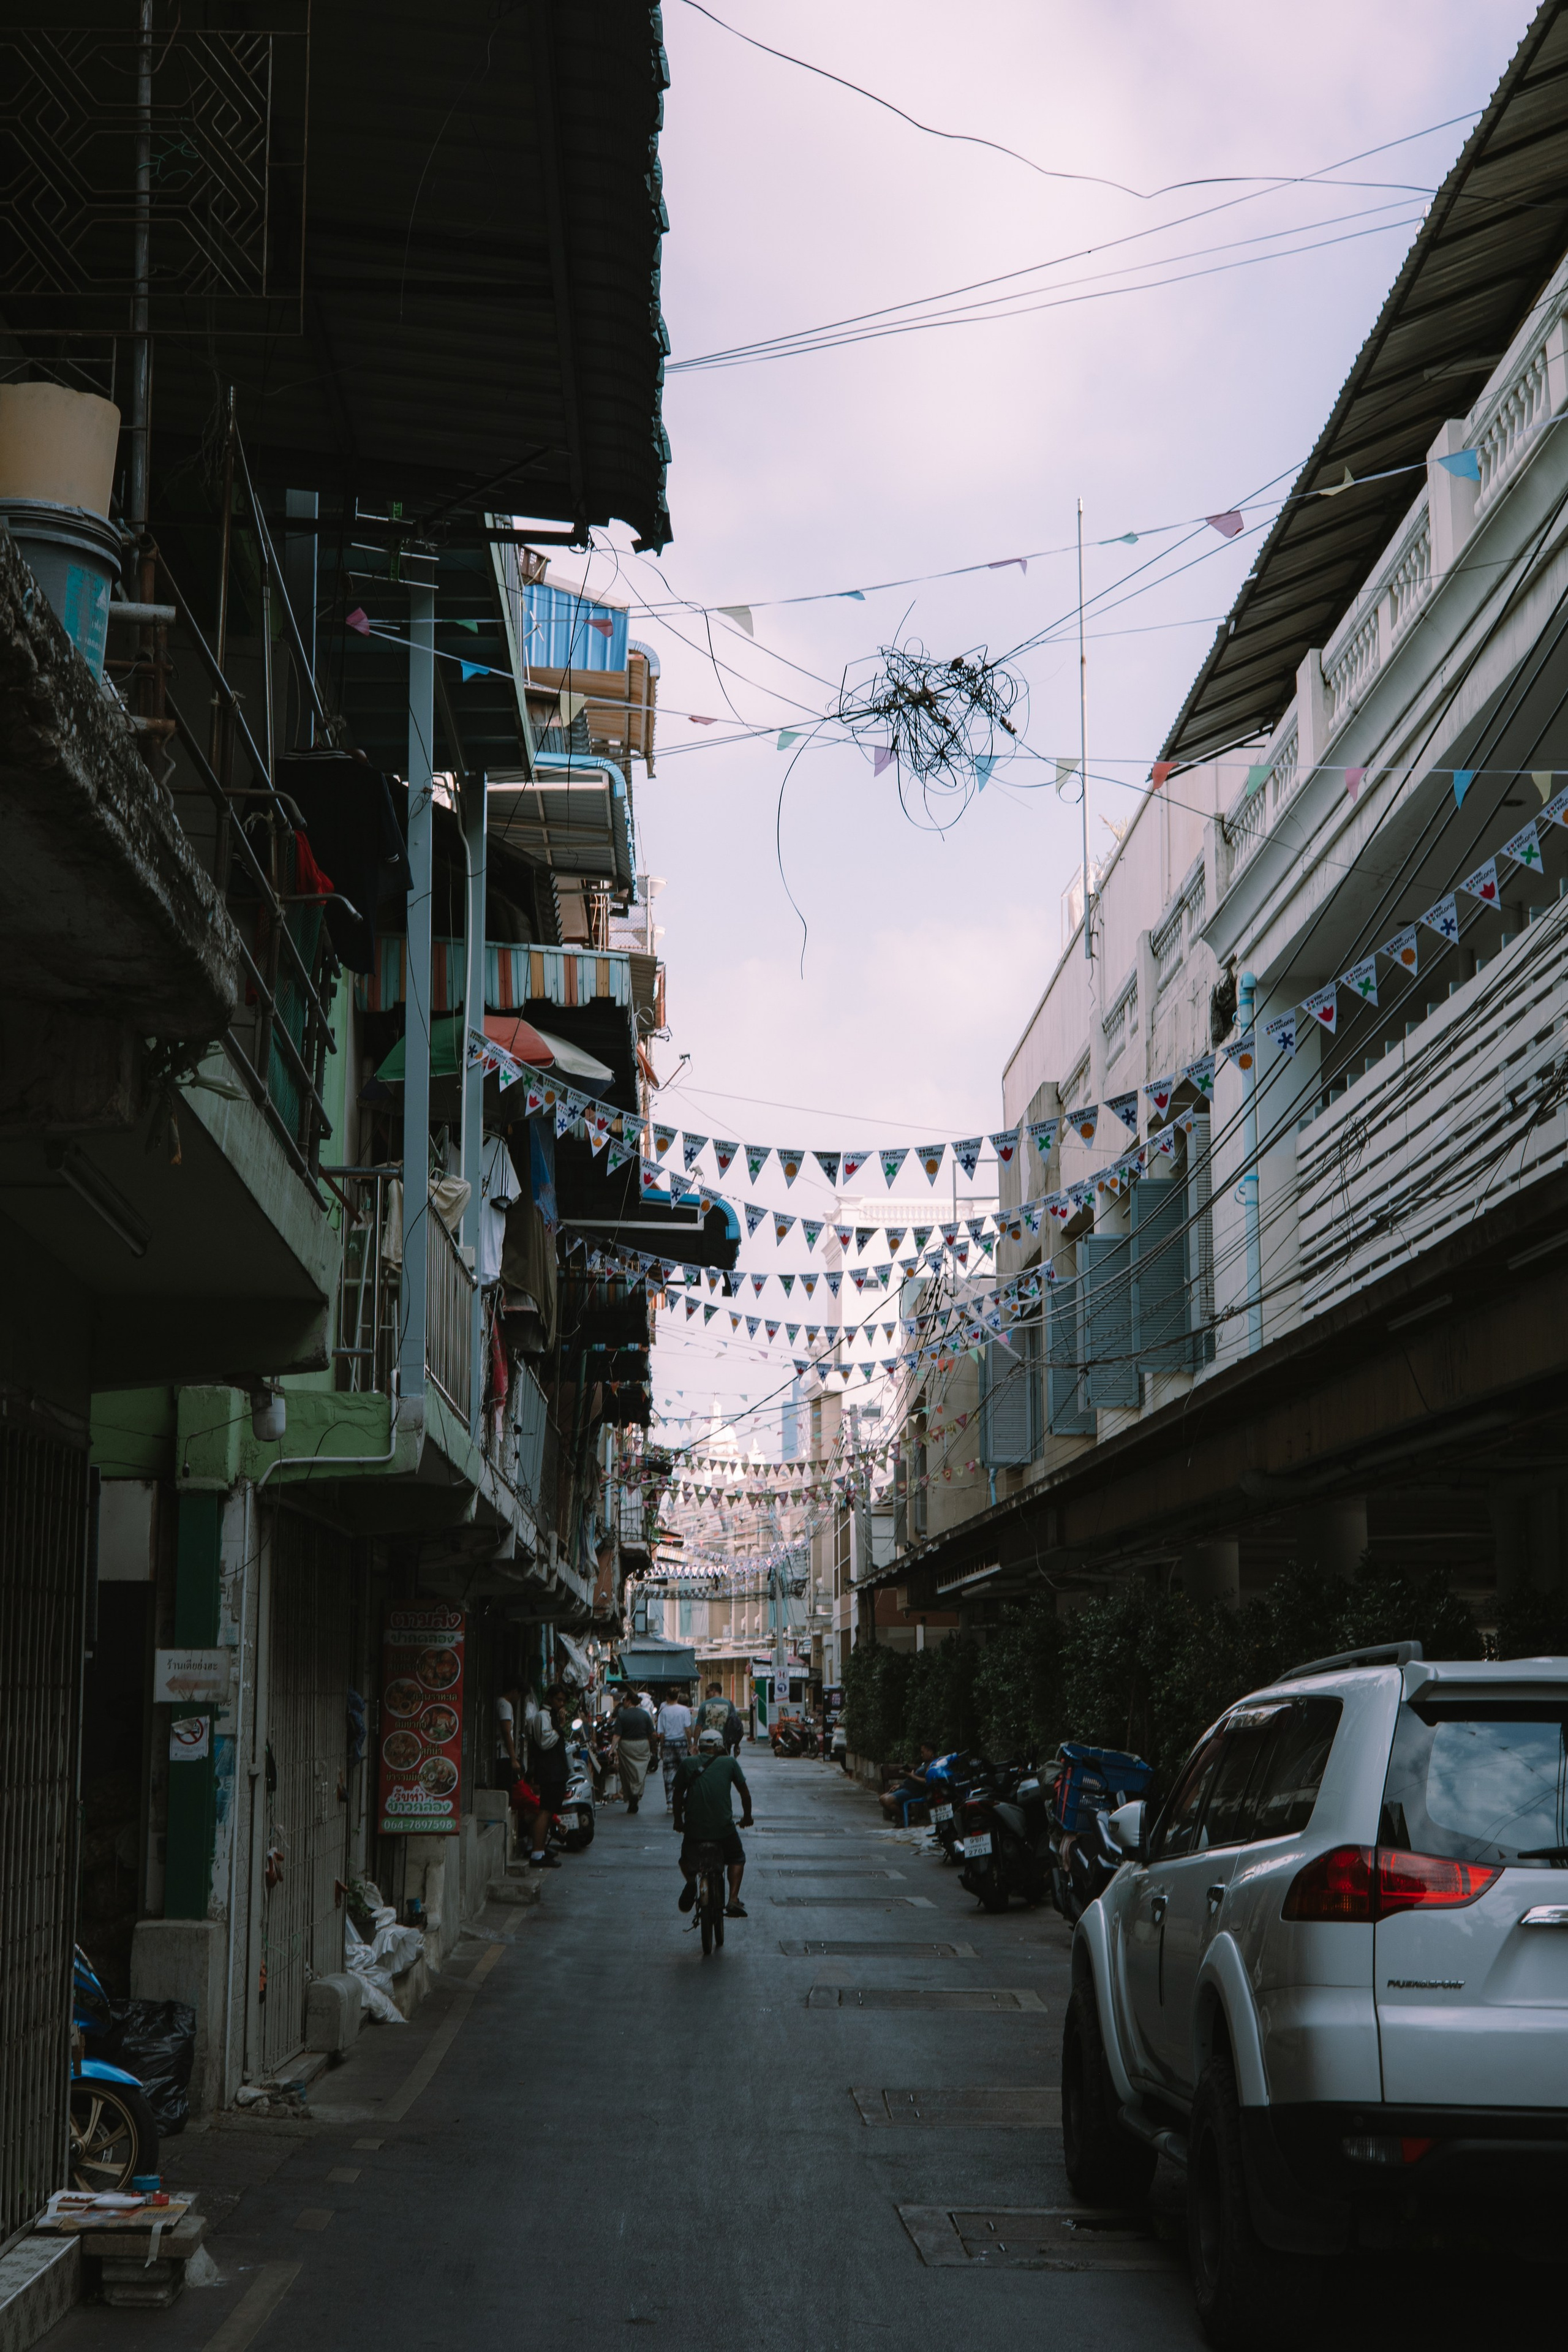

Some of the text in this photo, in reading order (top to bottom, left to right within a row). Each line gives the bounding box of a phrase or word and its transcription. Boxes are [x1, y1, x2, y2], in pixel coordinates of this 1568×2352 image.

[391, 1604, 461, 1629] ตามสั่ง
[391, 1631, 454, 1643] ปากคลอง
[394, 1789, 424, 1802] รับทำ
[388, 1798, 451, 1812] ข้าวกล่อง
[383, 1820, 453, 1830] 064-7897598
